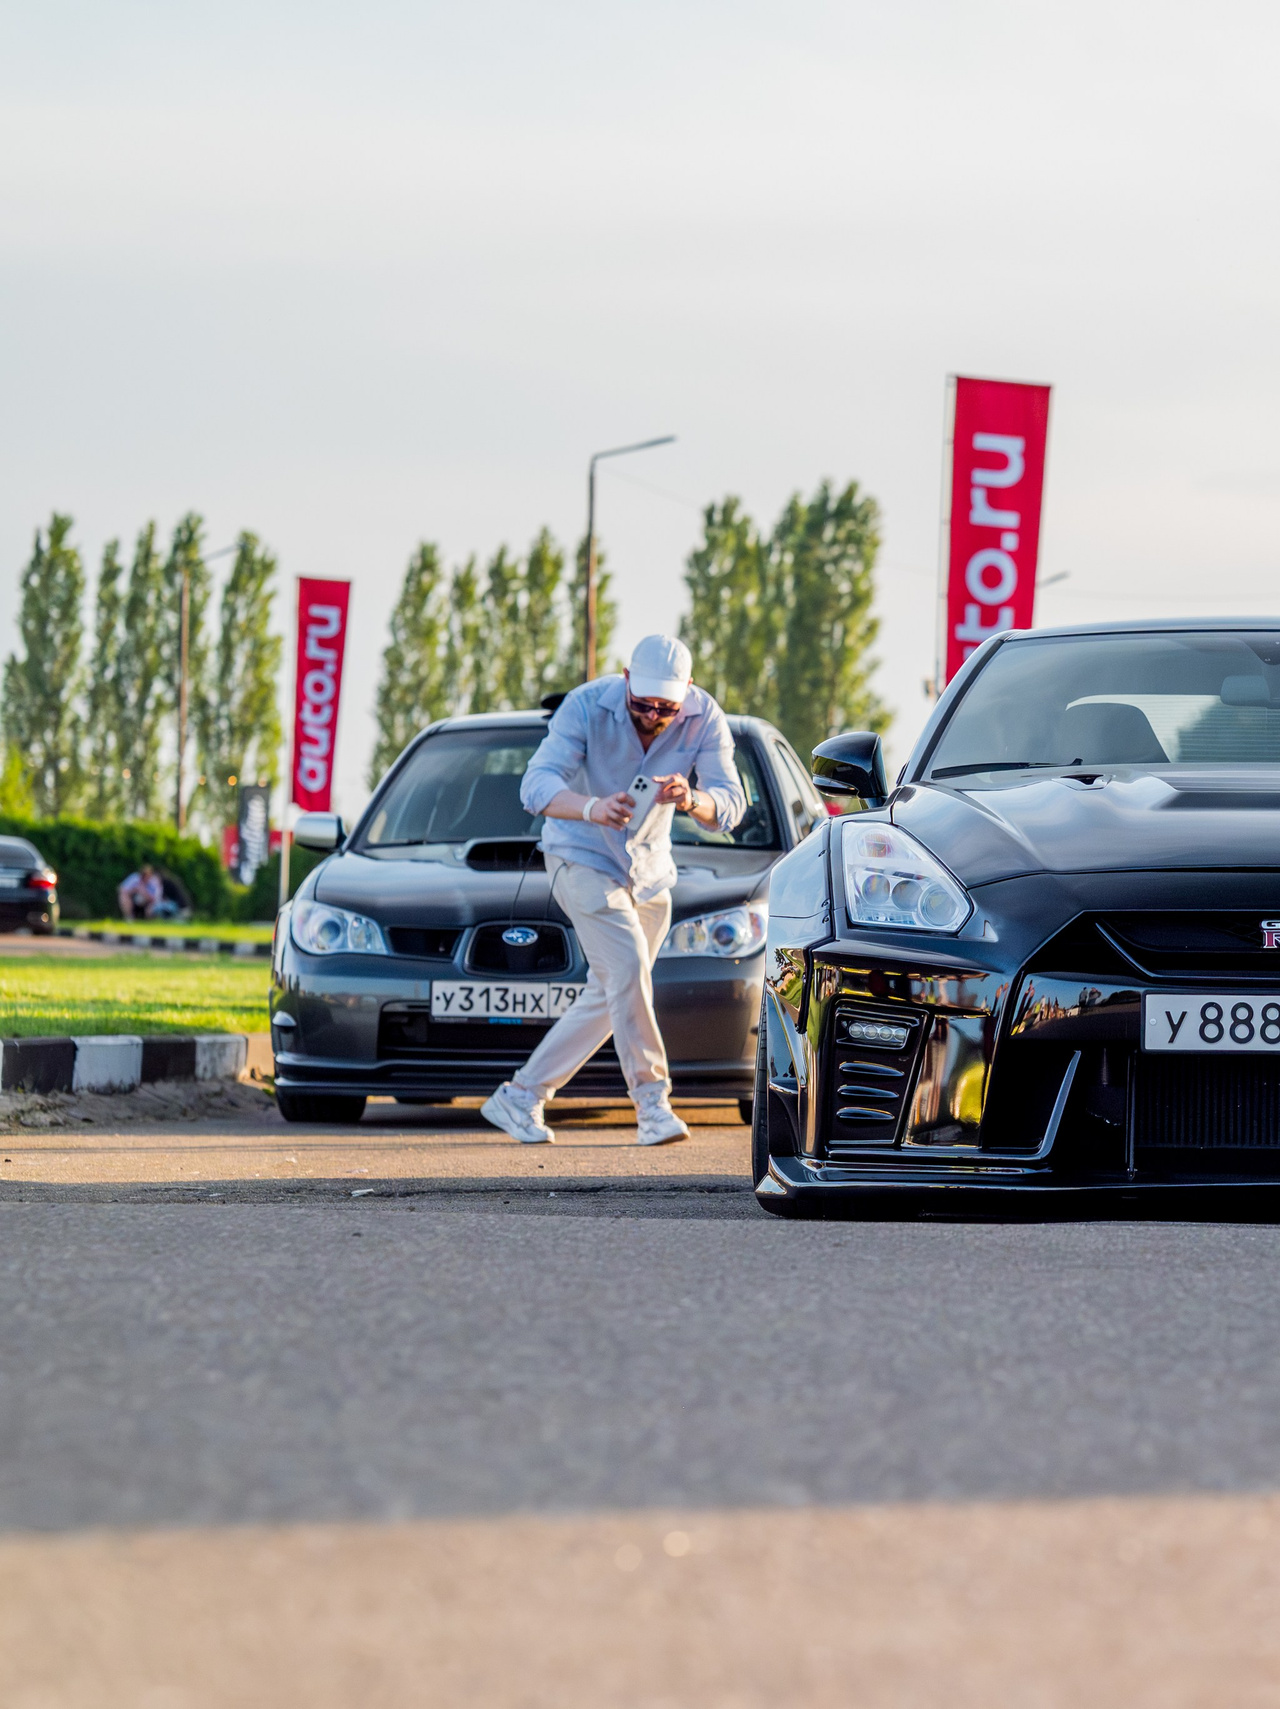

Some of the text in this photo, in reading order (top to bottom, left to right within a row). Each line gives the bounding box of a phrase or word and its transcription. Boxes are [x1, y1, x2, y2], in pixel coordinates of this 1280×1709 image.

[954, 431, 1026, 662] to.ru
[298, 603, 342, 793] auto.ru
[551, 986, 585, 1007] 79
